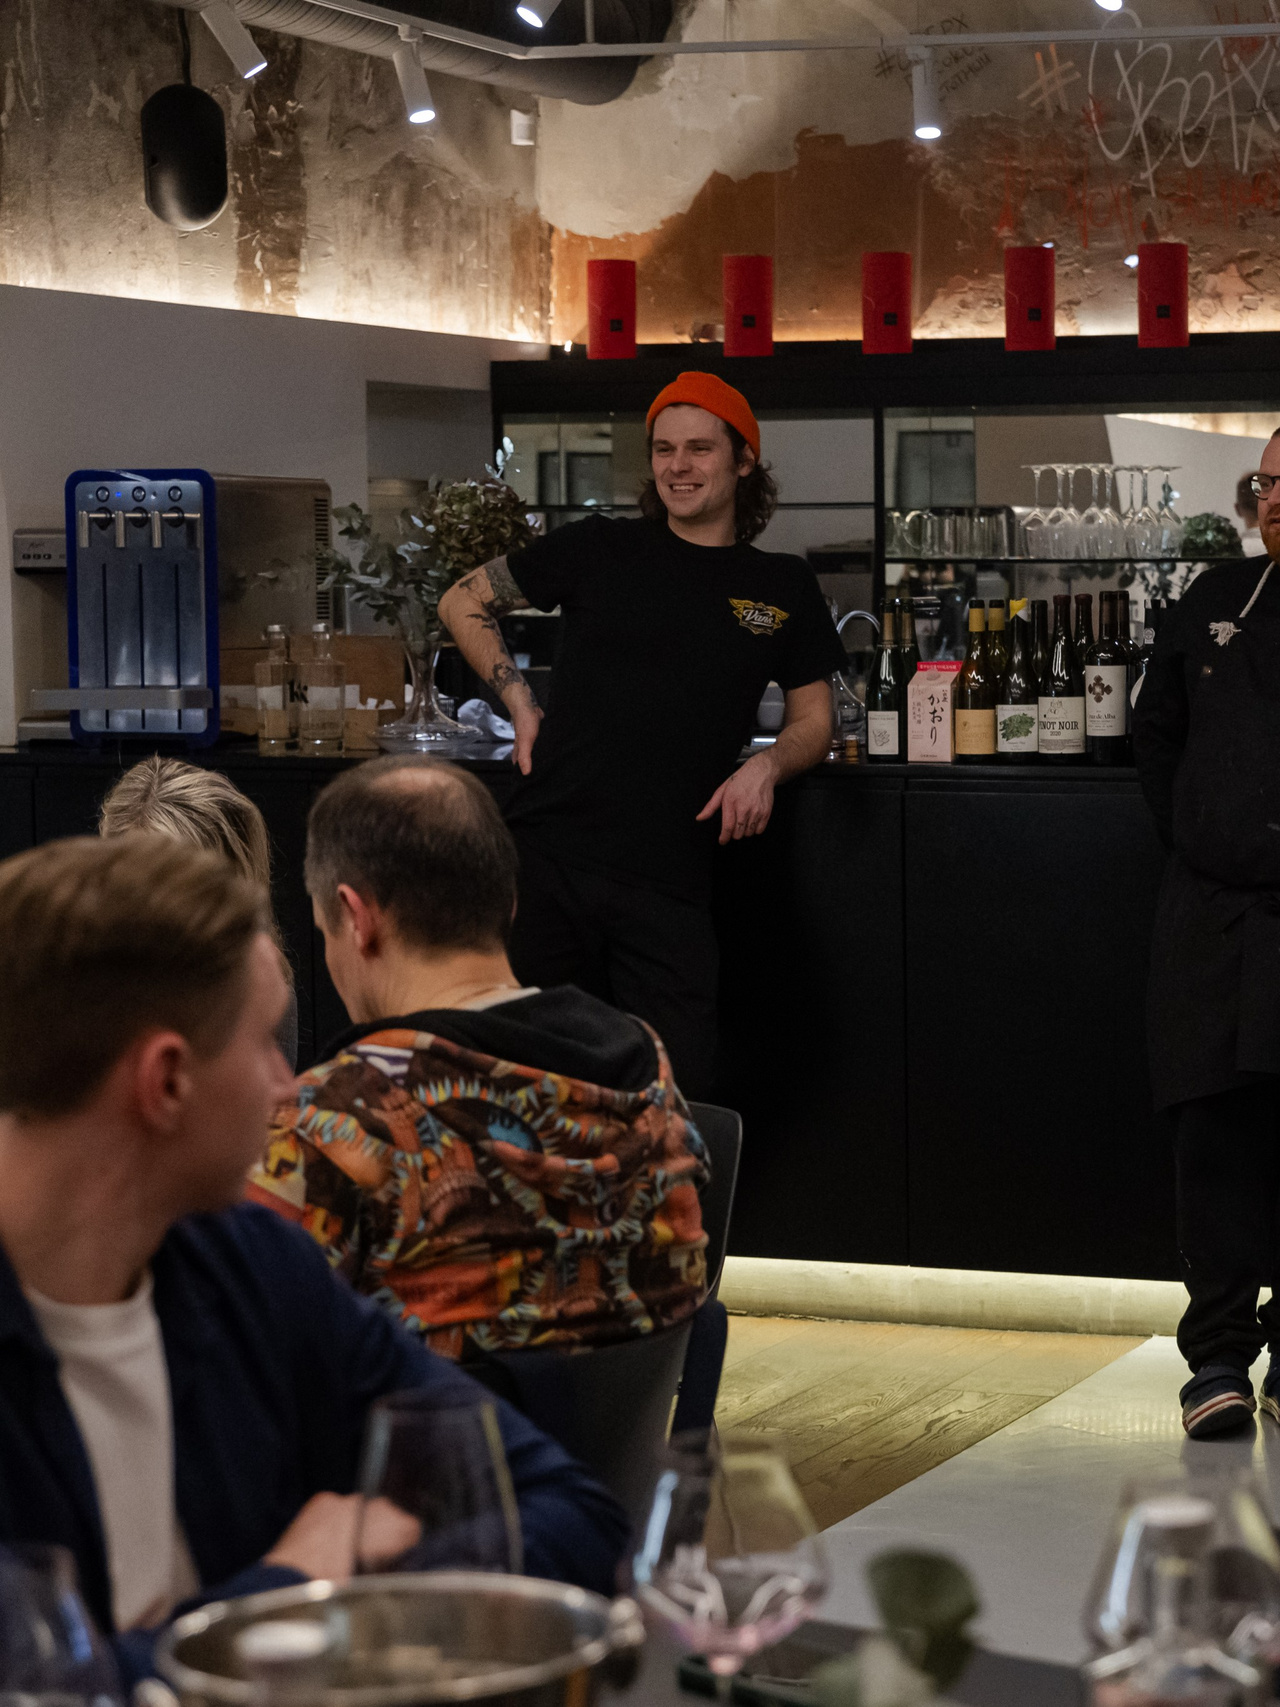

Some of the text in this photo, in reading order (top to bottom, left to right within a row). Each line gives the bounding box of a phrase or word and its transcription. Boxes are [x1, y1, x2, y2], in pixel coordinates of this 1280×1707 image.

[743, 609, 774, 626] Vans
[927, 694, 944, 746] かおり
[1058, 721, 1079, 730] NOIR
